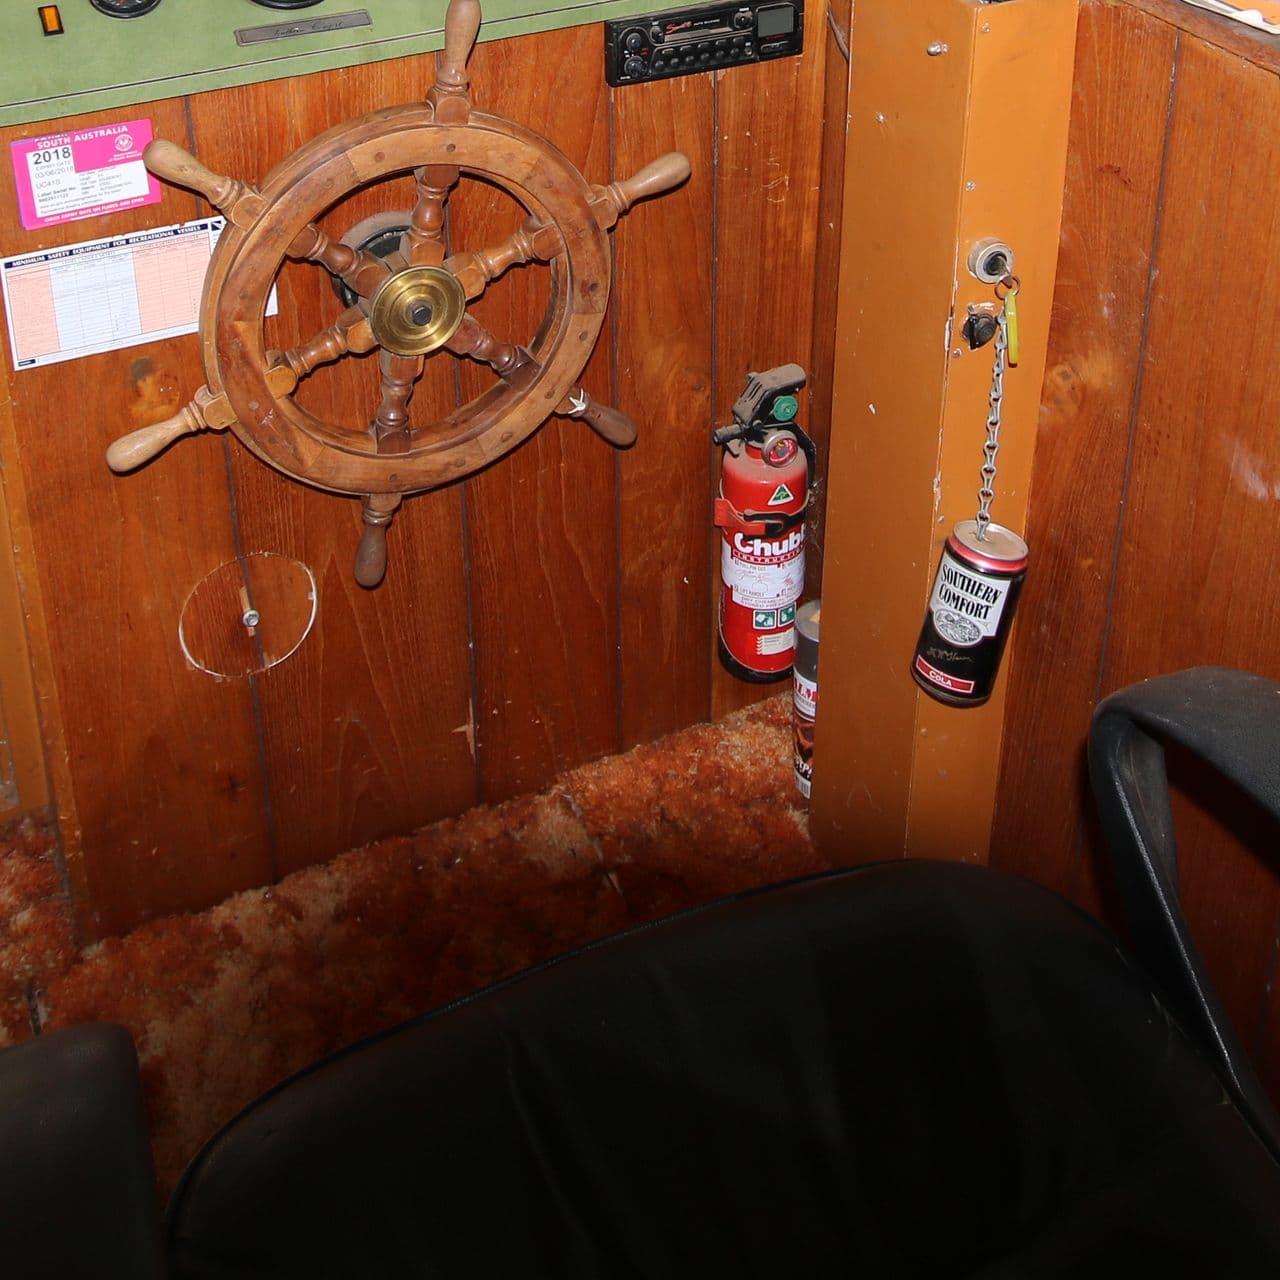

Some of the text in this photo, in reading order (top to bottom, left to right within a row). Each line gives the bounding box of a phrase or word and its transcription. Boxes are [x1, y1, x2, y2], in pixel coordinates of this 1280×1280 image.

[37, 136, 71, 150] SOUTH
[74, 124, 128, 143] AUSTRALIA
[32, 146, 72, 165] 2018
[11, 255, 45, 267] MINIMUM
[47, 250, 71, 260] SAFETY
[72, 242, 110, 255] EQUIPMENT
[176, 224, 202, 236] VESSELS
[942, 564, 1002, 605] SOUTHERN
[938, 583, 992, 620] COMFORT
[929, 670, 952, 687] COLA
